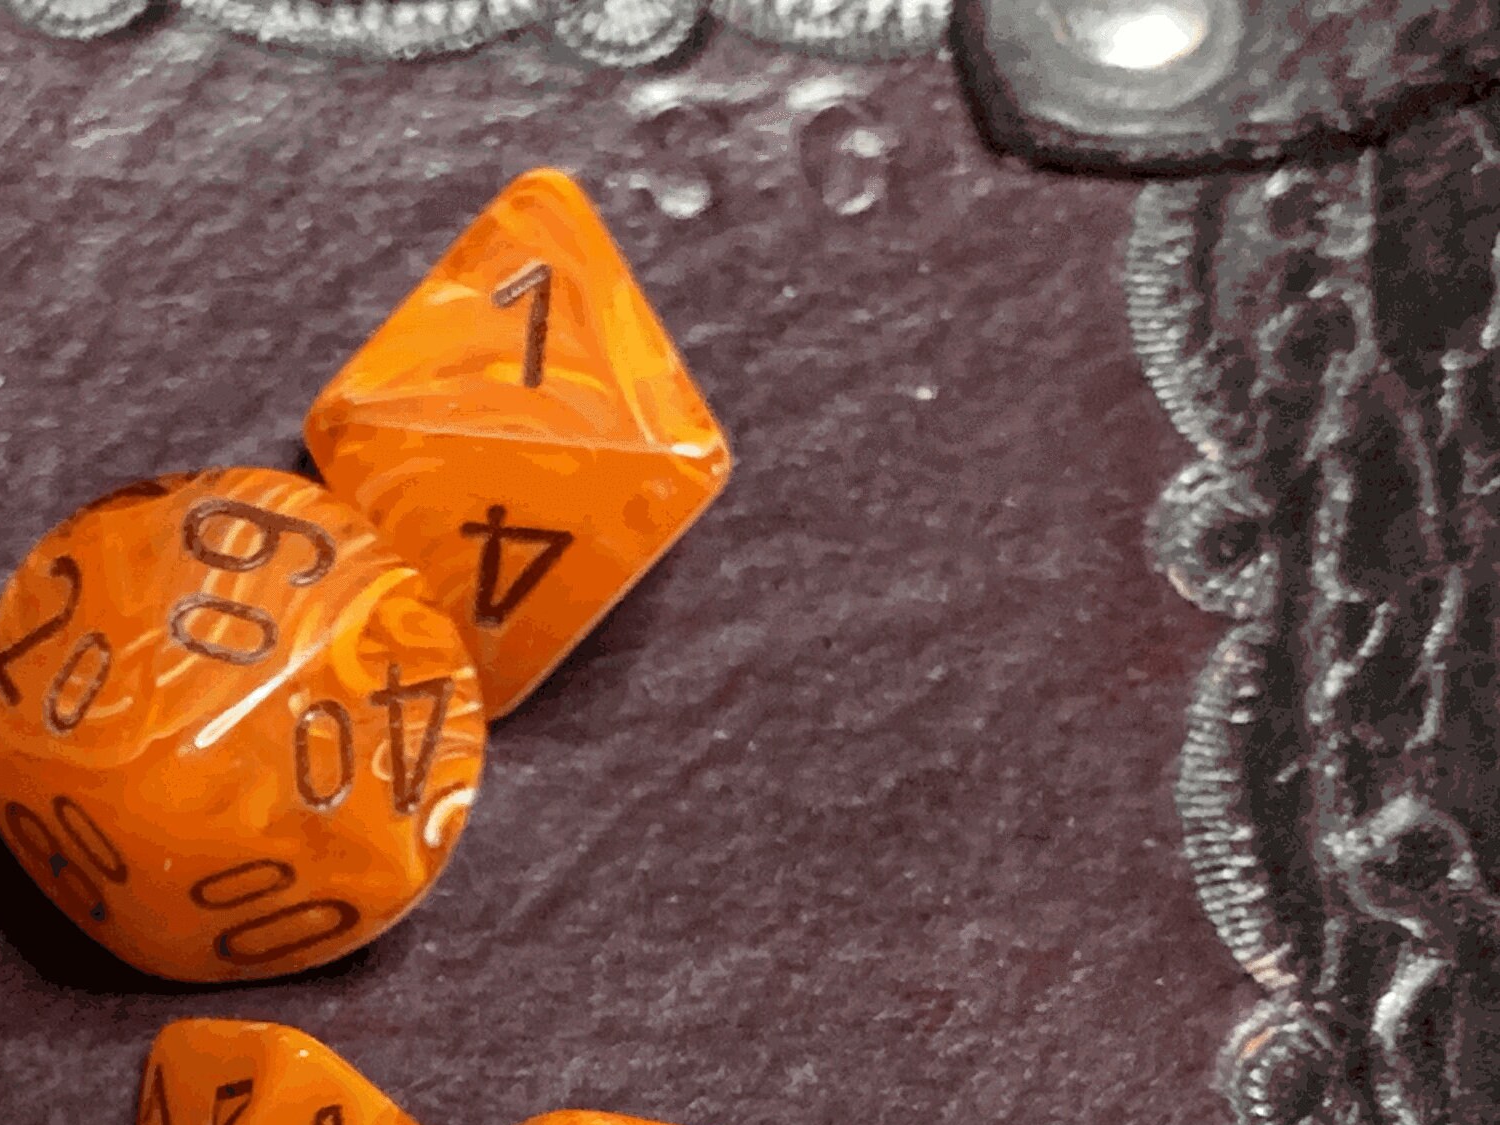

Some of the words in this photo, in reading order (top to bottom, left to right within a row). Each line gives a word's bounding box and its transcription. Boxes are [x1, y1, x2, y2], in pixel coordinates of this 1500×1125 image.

[491, 260, 553, 388] 1
[460, 503, 574, 628] 4
[295, 664, 455, 814] 40
[190, 860, 361, 966] 00
